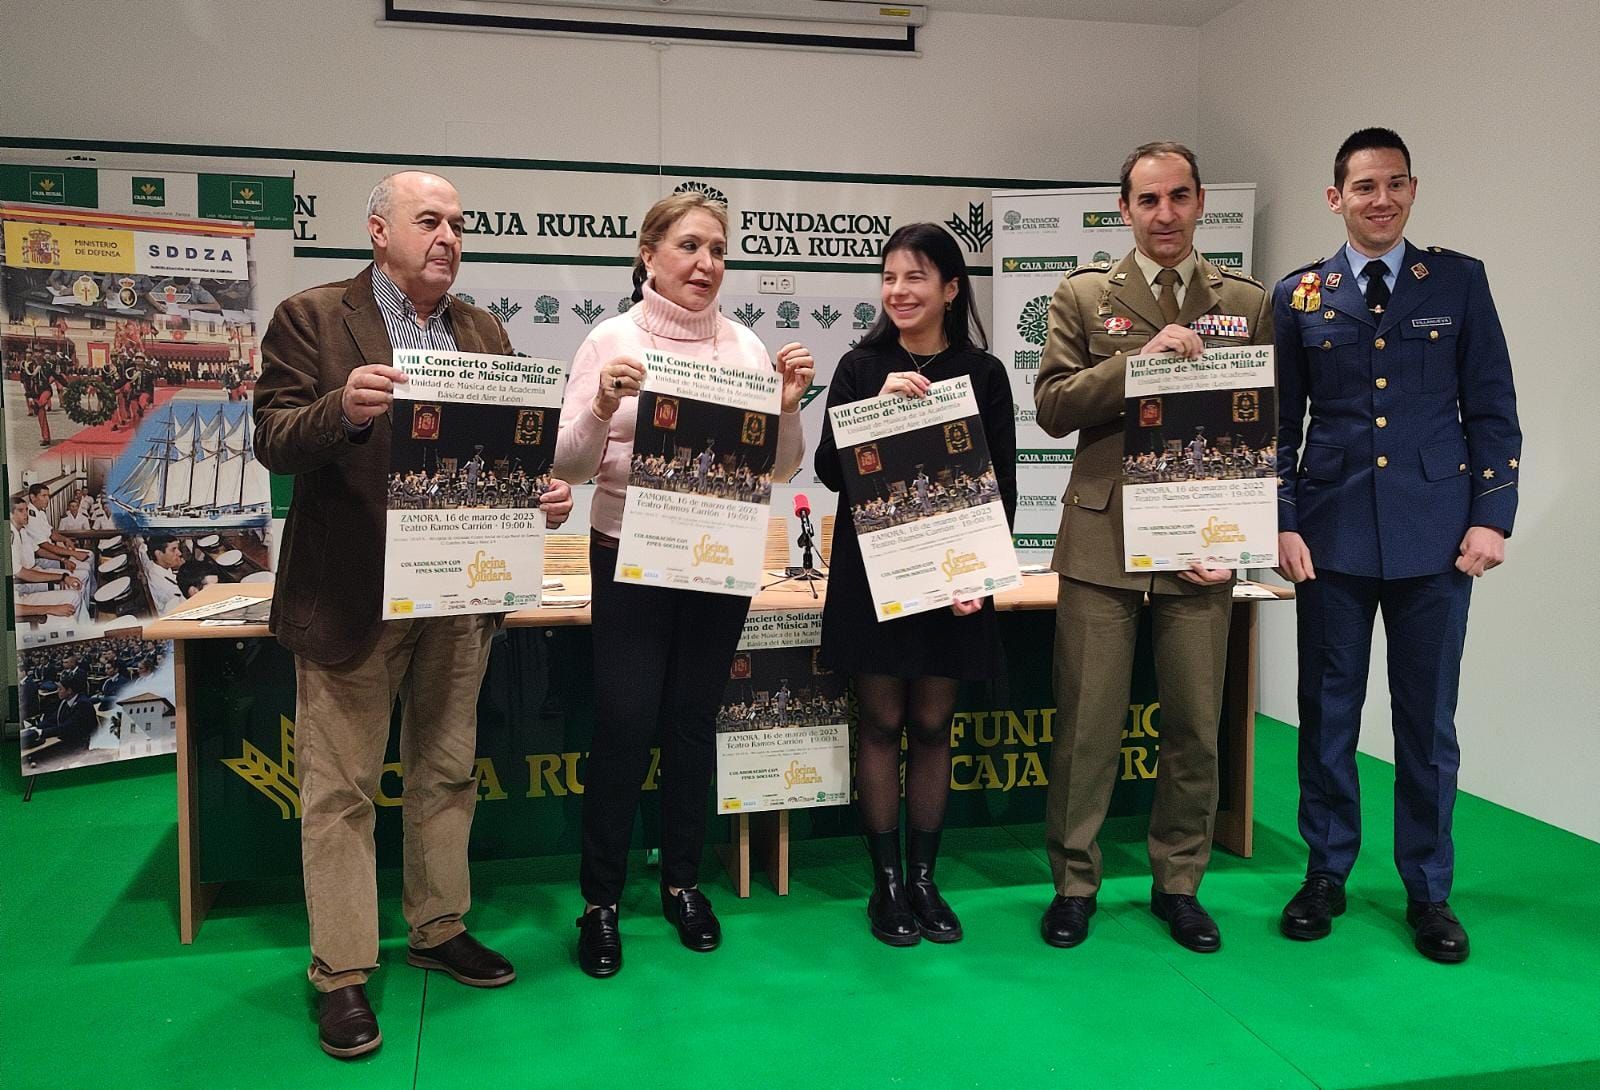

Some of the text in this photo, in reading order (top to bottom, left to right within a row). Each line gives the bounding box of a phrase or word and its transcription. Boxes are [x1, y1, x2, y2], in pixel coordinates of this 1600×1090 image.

[536, 213, 636, 239] RURAL
[741, 211, 892, 236] FUNDACION
[74, 240, 118, 249] MINISTERIO
[741, 234, 883, 258] CAJA RURAL
[75, 248, 121, 258] DE DEFENSA
[1020, 262, 1076, 270] CAJA RURAL
[398, 354, 561, 374] VIII Concierto Solidario de
[1130, 360, 1145, 368] VIII
[1201, 350, 1251, 362] Solidario
[1255, 350, 1269, 358] de
[401, 365, 558, 385] Invierno de Música Militar
[645, 352, 778, 385] VIII Concierto Solidario de
[1130, 358, 1266, 377] Invierno de Música Militar
[648, 362, 690, 377] Invierno
[693, 370, 705, 380] de
[709, 372, 742, 387] Música
[745, 380, 775, 393] Militar
[411, 378, 440, 387] Unidad
[443, 380, 454, 388] de
[456, 381, 484, 390] Música
[508, 385, 546, 394] Academia
[467, 392, 479, 400] del
[832, 379, 967, 419] VIII Concierto Sodario de
[836, 410, 880, 428] Invierno
[881, 406, 895, 416] de
[897, 396, 932, 413] Música
[934, 388, 967, 404] Militar
[1018, 454, 1074, 462] CAJA RURAL
[636, 499, 661, 509] Teatro
[677, 496, 687, 504] 16
[688, 498, 698, 506] de
[458, 513, 468, 521] de
[471, 513, 497, 521] marzo
[399, 523, 427, 531] Teatro
[430, 522, 459, 531] Ramos
[461, 522, 492, 530] Carrión
[500, 521, 524, 529] 19:00
[1018, 538, 1040, 546] CAJA
[744, 612, 824, 624] oncierto Solidari
[762, 623, 774, 631] de
[776, 621, 808, 630] Música
[951, 752, 1049, 792] CAJA
